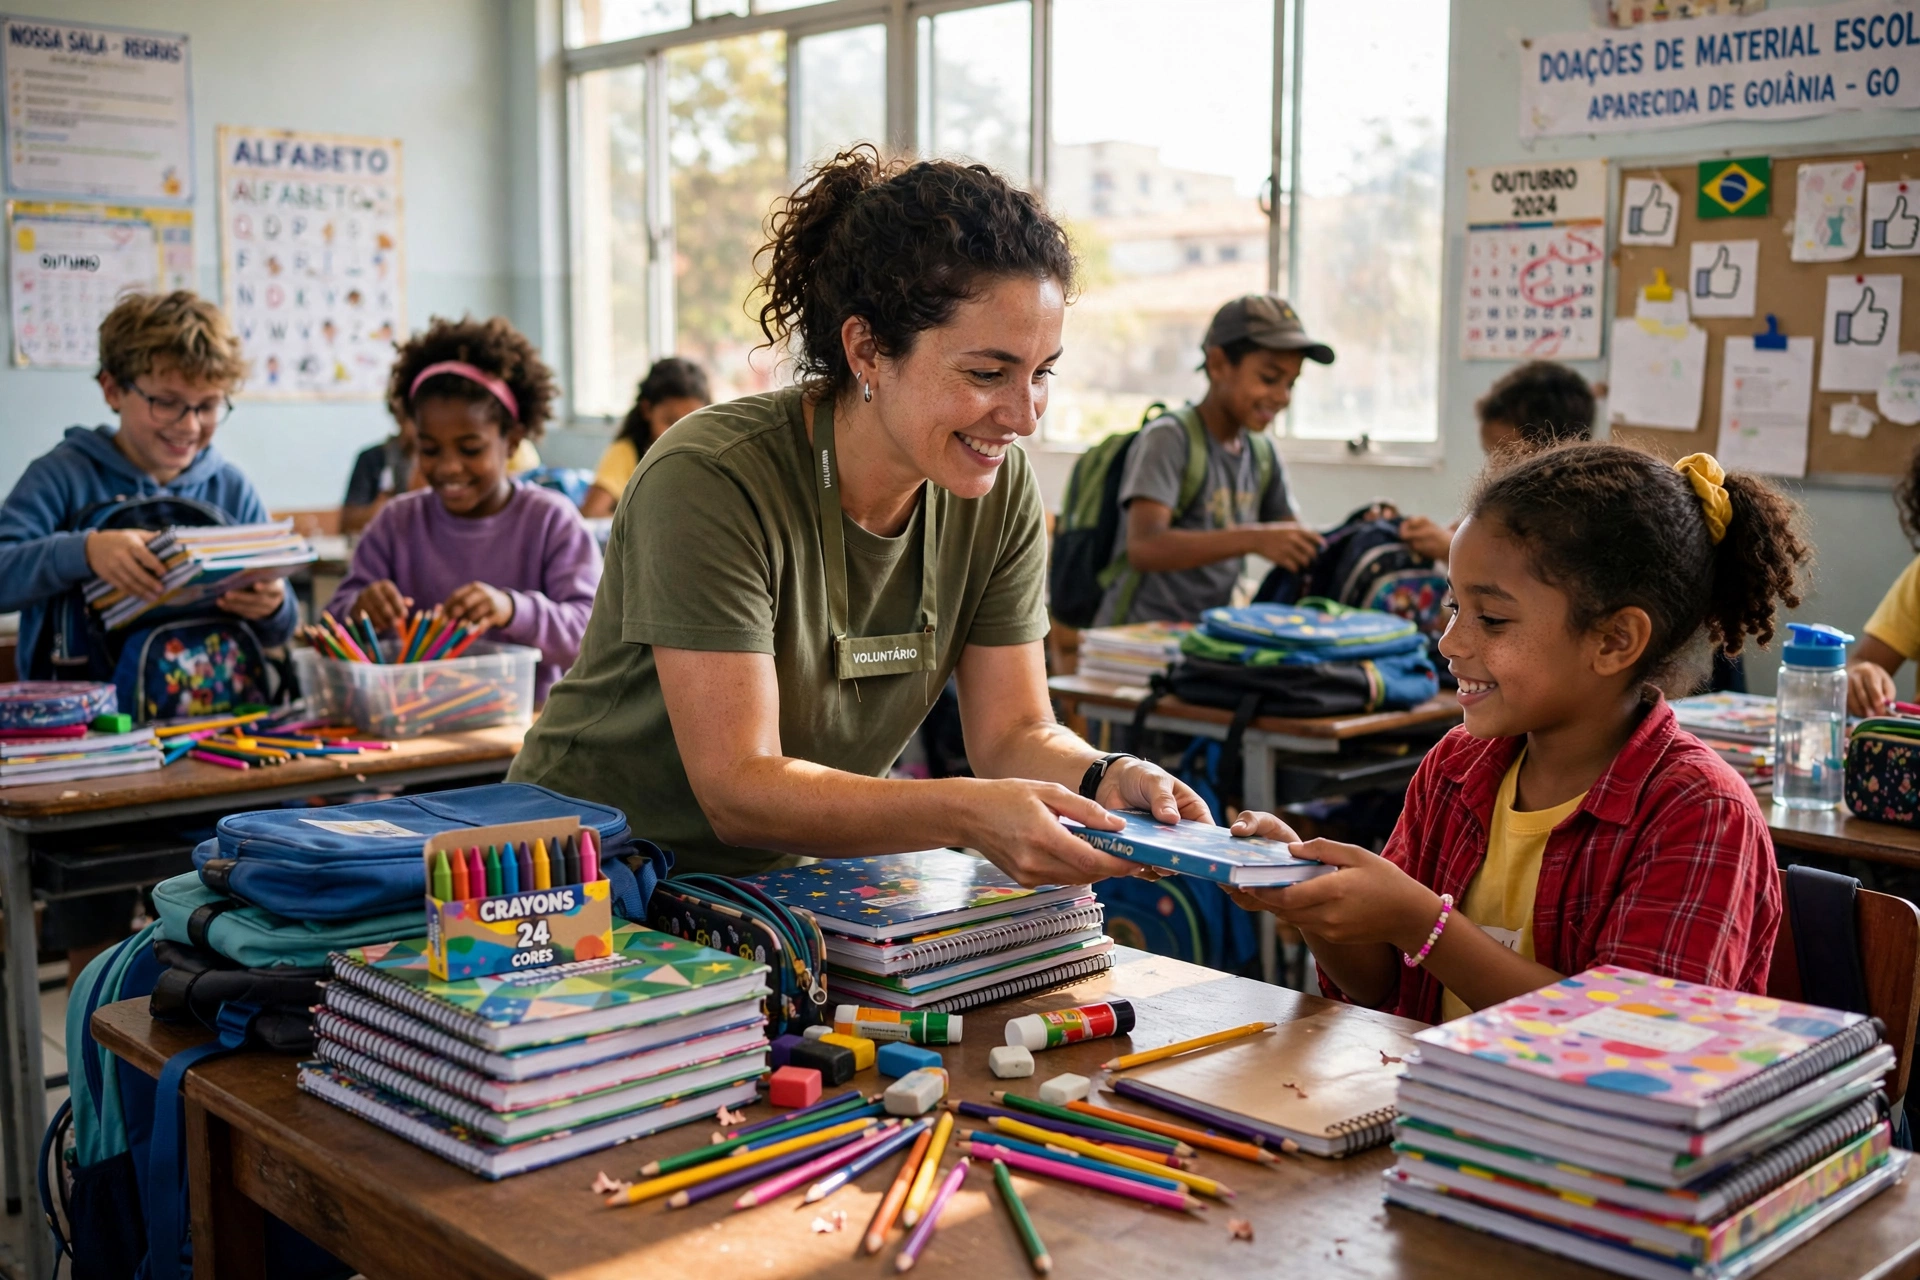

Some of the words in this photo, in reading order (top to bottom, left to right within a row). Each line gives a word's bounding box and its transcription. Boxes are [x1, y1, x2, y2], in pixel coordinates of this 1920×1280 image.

[9, 24, 63, 49] NOSSA
[67, 30, 108, 55] SALA
[1539, 39, 1643, 85] DOAÇÕES
[1654, 38, 1685, 71] DE
[1696, 23, 1820, 67] MATERIAL
[1588, 87, 1700, 121] APARECIDA
[1708, 83, 1736, 112] DE
[1744, 70, 1836, 108] GOIÂNIA
[1866, 66, 1900, 97] GO
[233, 139, 389, 175] ALFABETO
[1491, 167, 1578, 194] OUTUBRO
[1512, 194, 1557, 217] 2024
[853, 646, 918, 664] VOLUNTÁRIO
[480, 890, 575, 922] CRAYONS
[516, 920, 551, 948] 24
[511, 949, 554, 968] CORES
